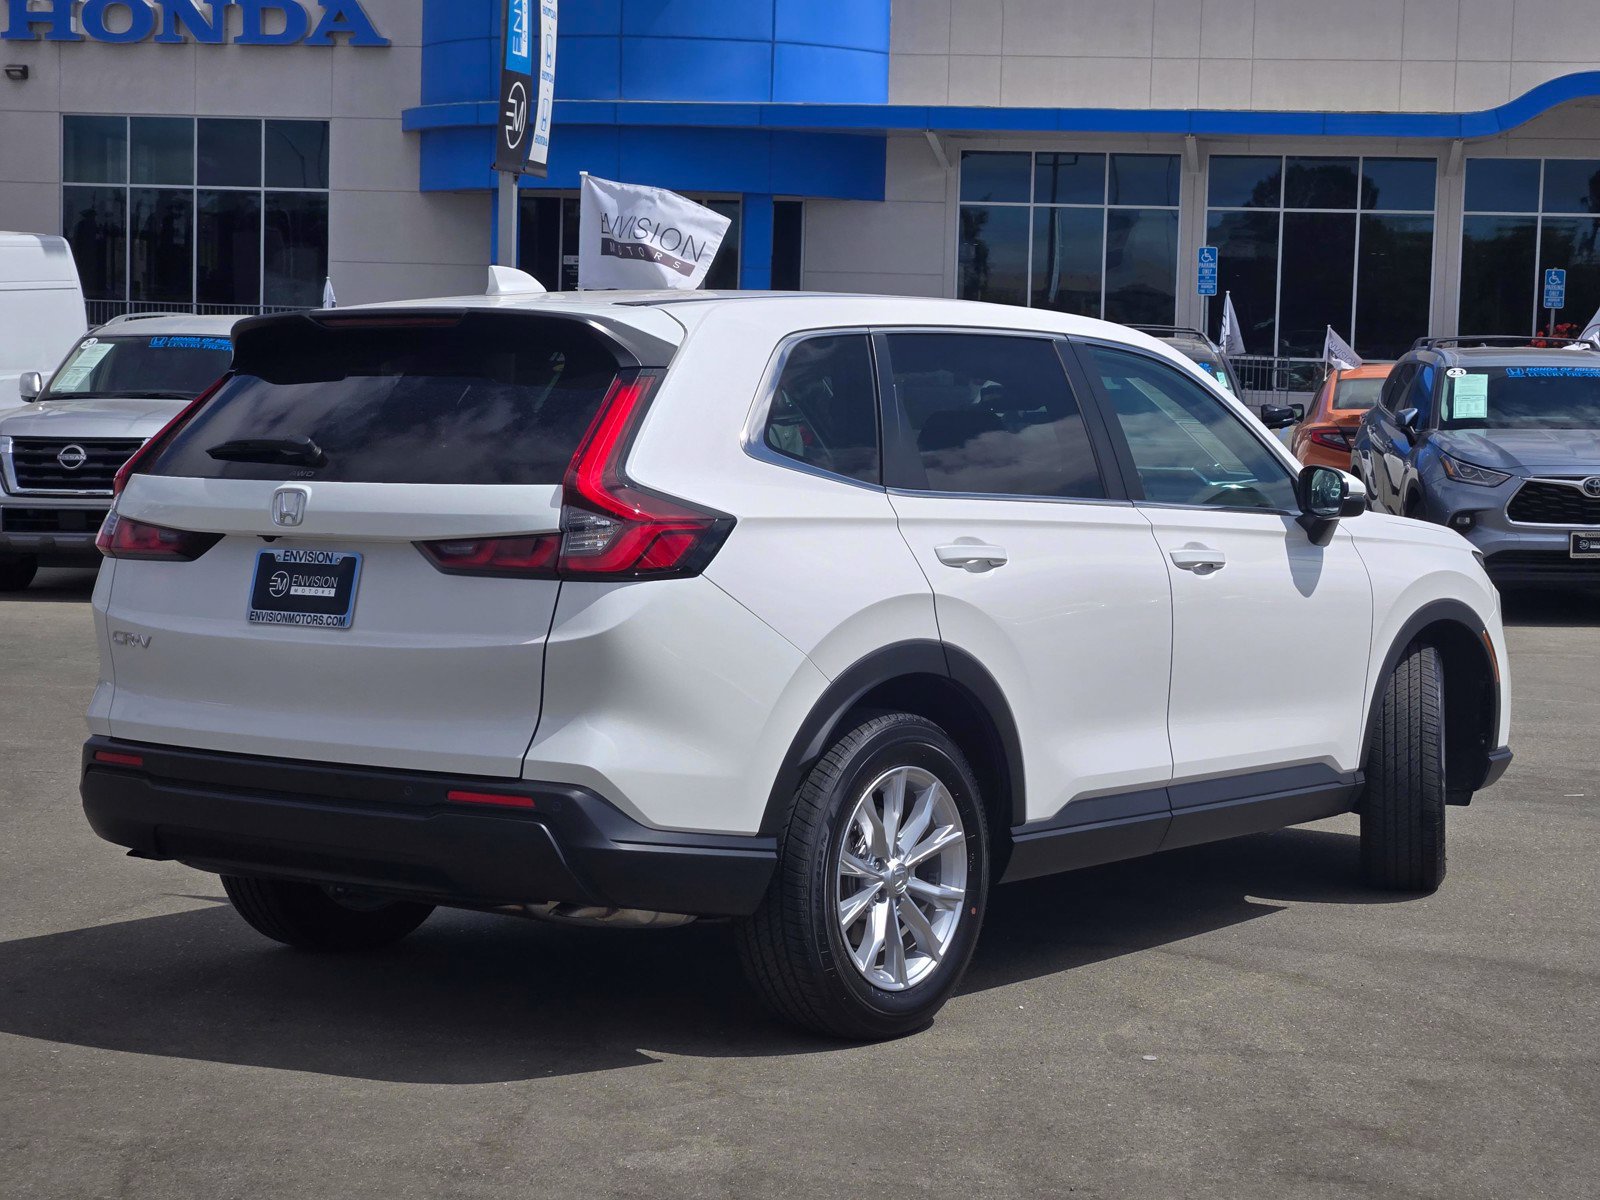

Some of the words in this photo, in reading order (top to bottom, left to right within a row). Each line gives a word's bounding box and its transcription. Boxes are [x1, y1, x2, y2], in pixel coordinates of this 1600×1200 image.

[0, 0, 391, 47] HONDA
[283, 550, 334, 564] ENVISION
[291, 574, 338, 588] ENVISION
[249, 611, 346, 627] ENVISIONMOTORS.COM
